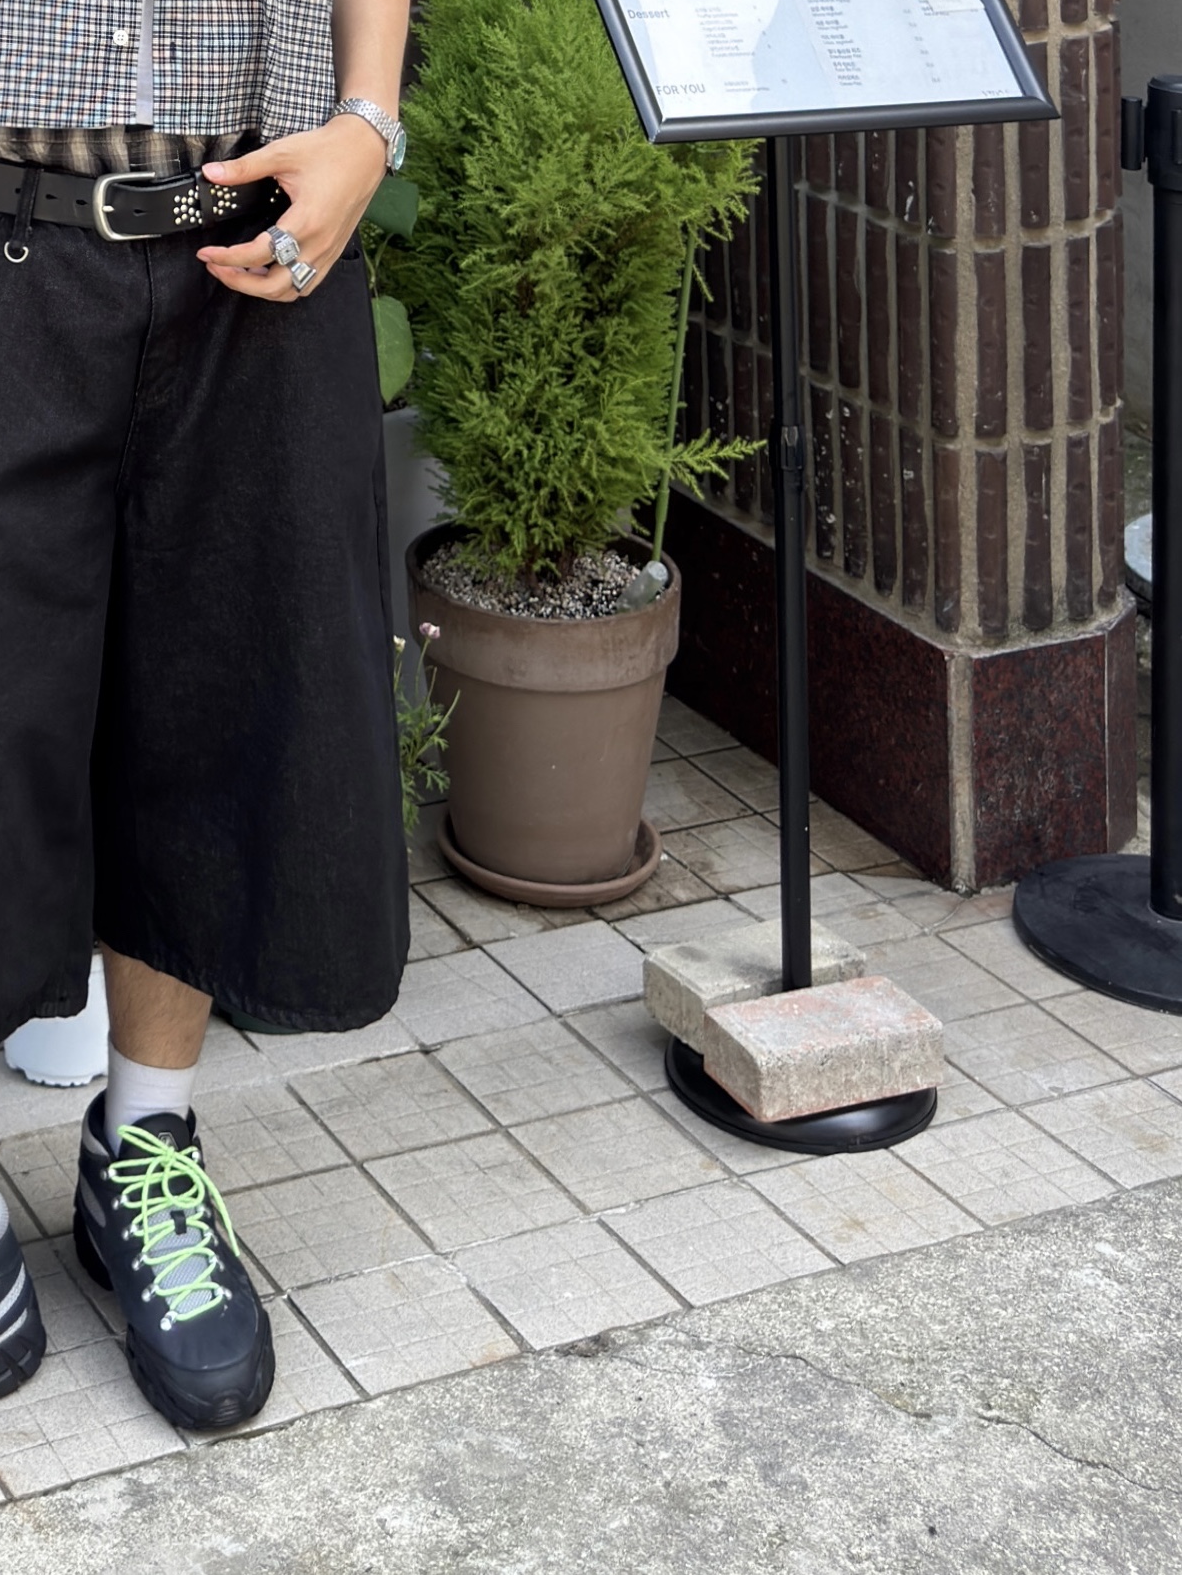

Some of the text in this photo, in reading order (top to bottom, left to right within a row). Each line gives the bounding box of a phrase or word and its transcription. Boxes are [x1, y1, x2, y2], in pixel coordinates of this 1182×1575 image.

[627, 8, 670, 20] Dessert
[655, 83, 706, 96] FOR YOU
